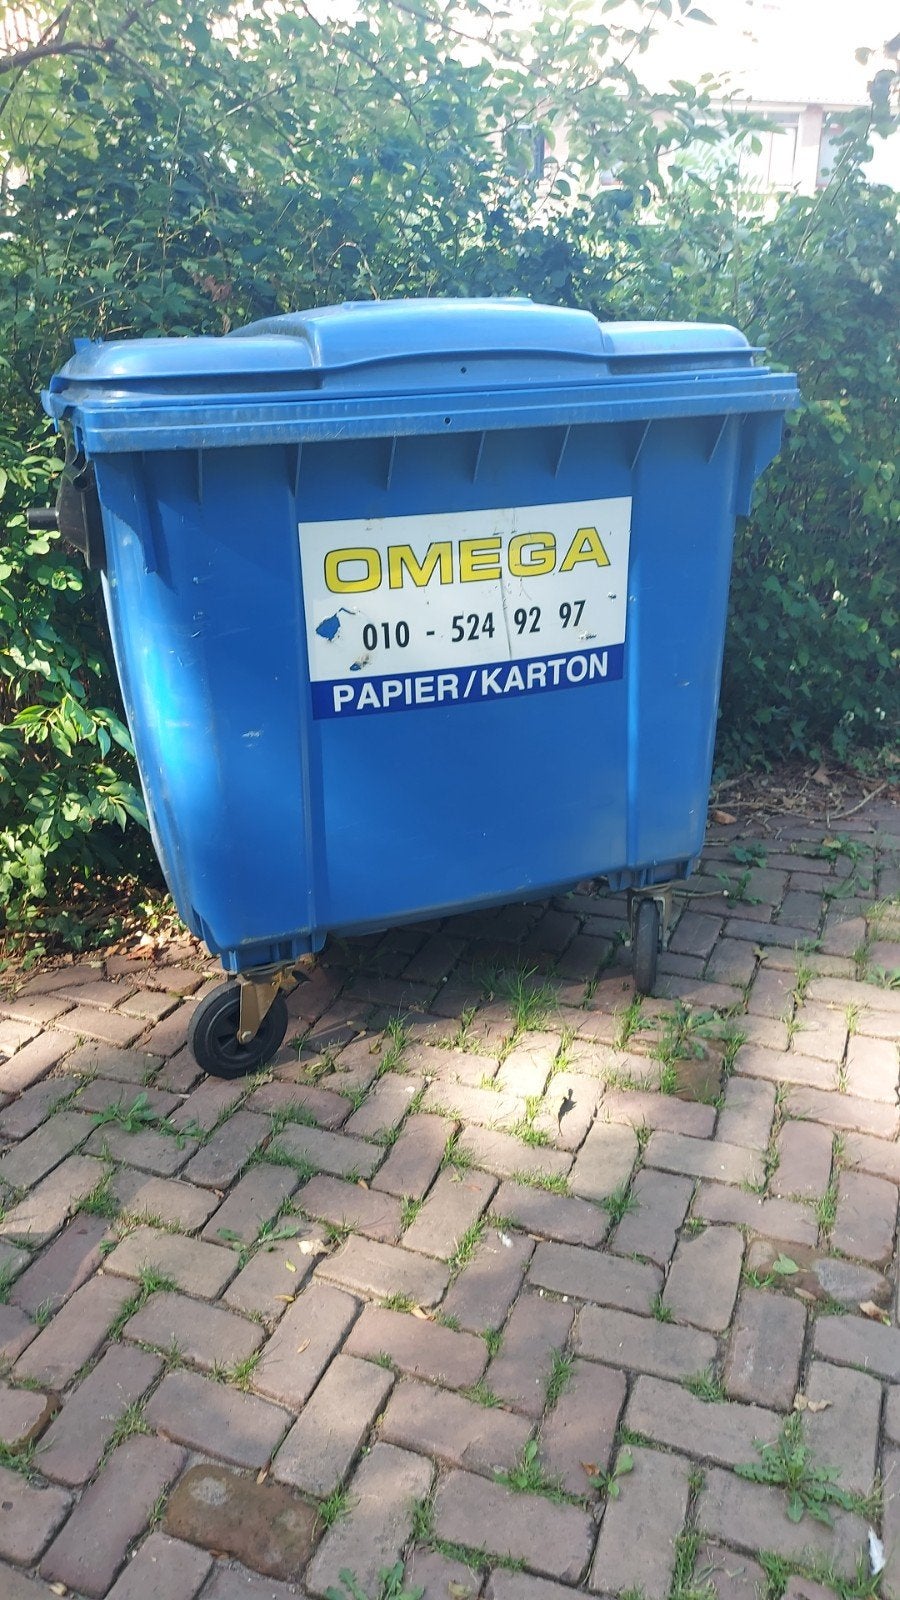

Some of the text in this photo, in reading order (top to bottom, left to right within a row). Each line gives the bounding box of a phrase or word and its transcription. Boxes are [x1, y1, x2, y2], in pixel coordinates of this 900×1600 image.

[324, 526, 611, 594] OMEGA
[362, 620, 410, 651] 010
[451, 612, 495, 643] 524
[514, 606, 541, 635] 92
[559, 600, 586, 628] 97
[332, 651, 608, 713] PAPIER/KARTON
